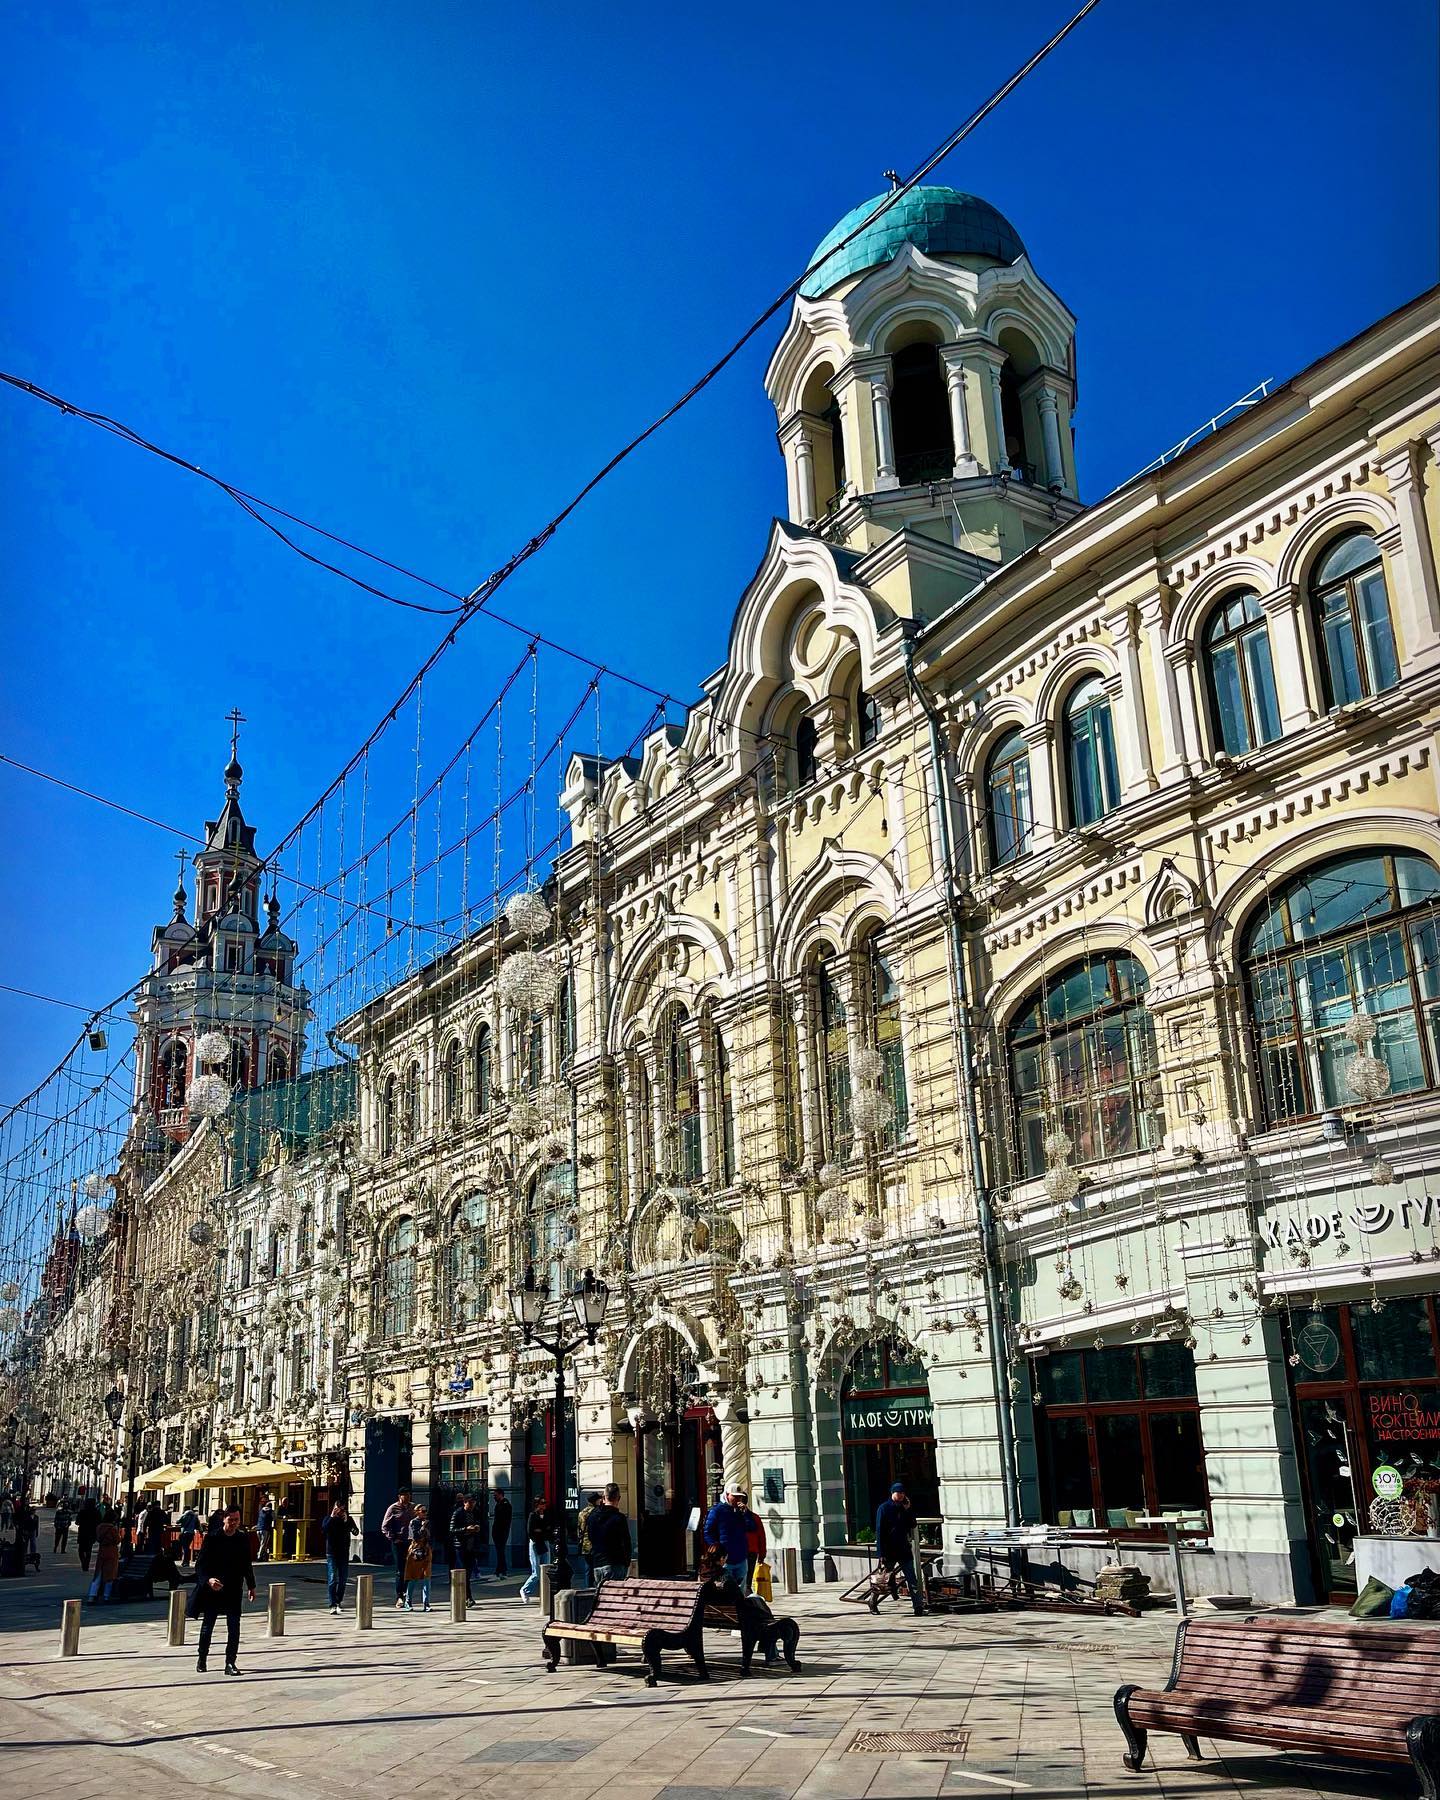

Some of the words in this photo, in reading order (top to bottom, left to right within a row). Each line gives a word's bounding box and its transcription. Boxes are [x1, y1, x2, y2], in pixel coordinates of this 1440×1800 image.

[1264, 1210, 1345, 1249] КАФЕ
[1370, 1394, 1418, 1412] ВИНО
[850, 1411, 883, 1428] КАФЕ
[904, 1409, 934, 1426] ГУРМ
[1374, 1473, 1401, 1484] -30%
